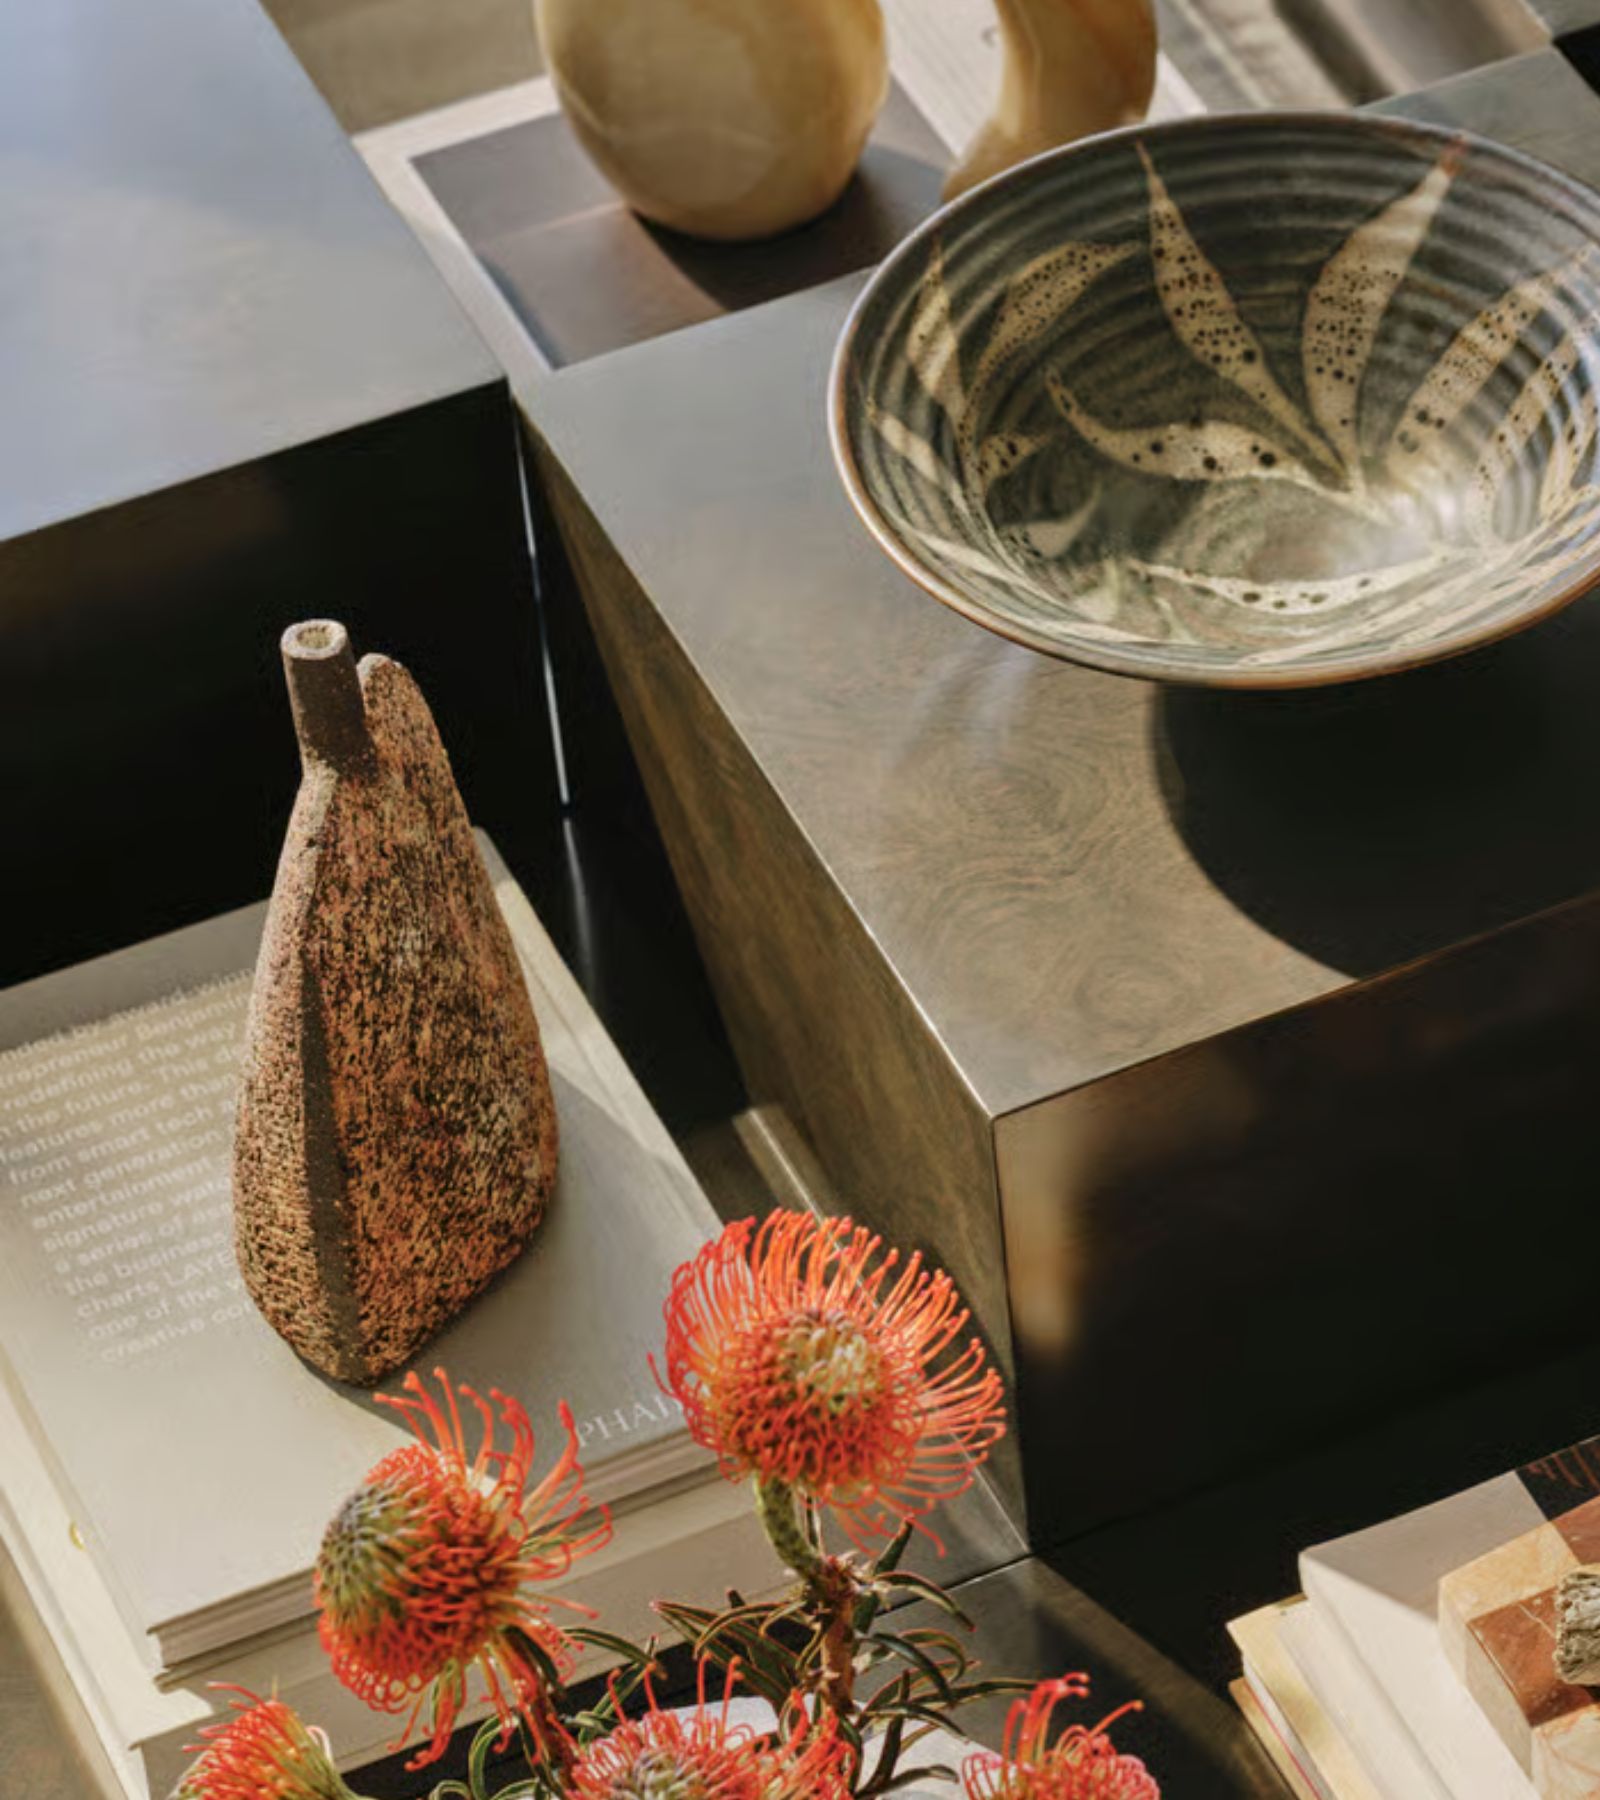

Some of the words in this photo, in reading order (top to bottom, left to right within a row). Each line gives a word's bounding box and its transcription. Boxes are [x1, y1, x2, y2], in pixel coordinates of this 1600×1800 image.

[4, 1057, 134, 1110] redefining
[138, 1041, 181, 1066] the
[185, 1021, 236, 1048] way
[17, 1109, 60, 1133] the
[153, 1057, 209, 1084] This
[111, 1094, 175, 1127] more
[180, 1071, 237, 1099] than
[9, 1154, 72, 1186] from
[78, 1128, 151, 1163] smart
[156, 1104, 215, 1135] tech
[20, 1177, 76, 1208] next
[83, 1129, 222, 1188] generation
[32, 1156, 212, 1230] entertainment
[43, 1200, 163, 1252] signature
[55, 1260, 70, 1274] a
[77, 1231, 152, 1267] series
[158, 1215, 185, 1239] of
[64, 1271, 109, 1297] the
[113, 1230, 227, 1278] business
[77, 1278, 160, 1318] charts
[89, 1314, 138, 1340] one
[145, 1297, 171, 1321] of
[177, 1284, 220, 1309] the
[101, 1316, 205, 1362] creative
